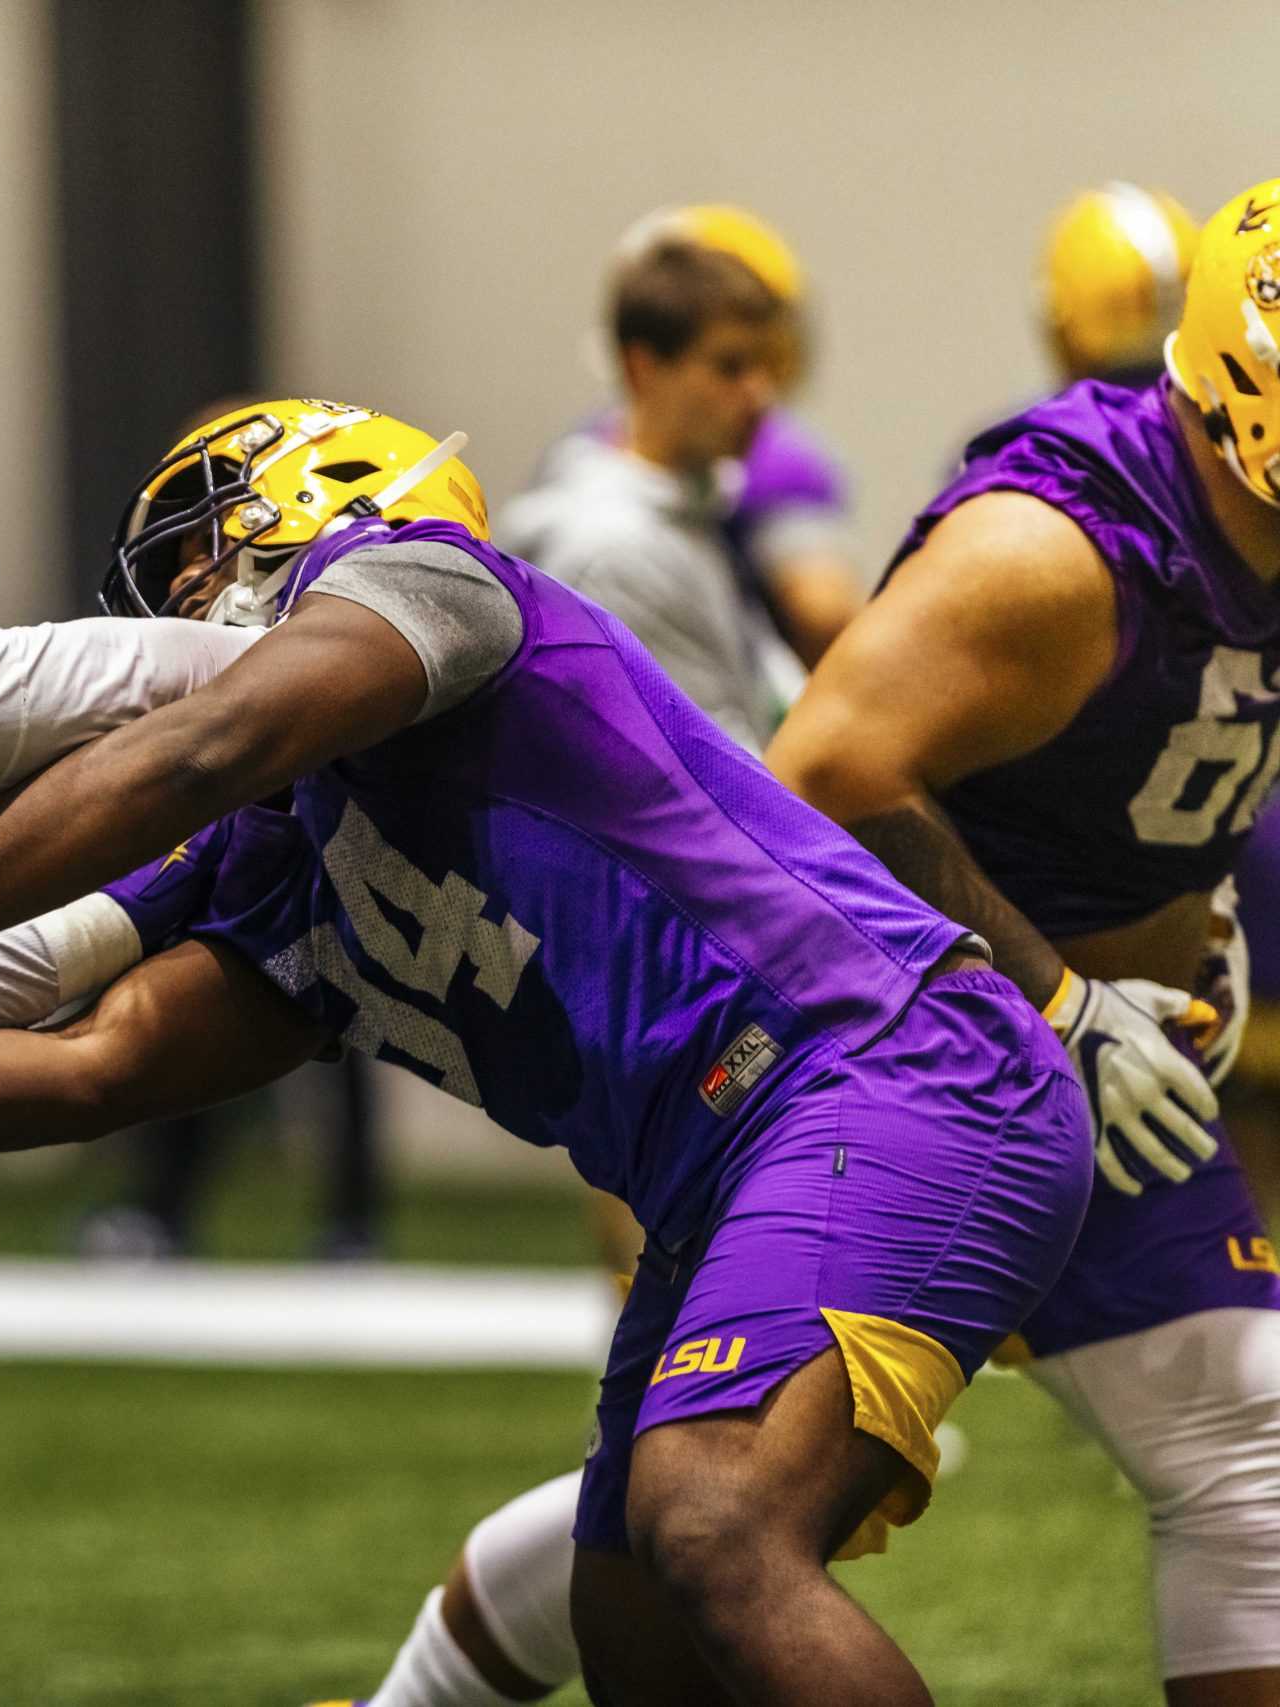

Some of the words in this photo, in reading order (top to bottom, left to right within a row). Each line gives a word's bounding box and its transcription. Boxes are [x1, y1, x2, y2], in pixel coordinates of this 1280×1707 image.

[723, 1040, 760, 1075] XXL
[1227, 1236, 1280, 1274] LS
[650, 1337, 747, 1386] LSU
